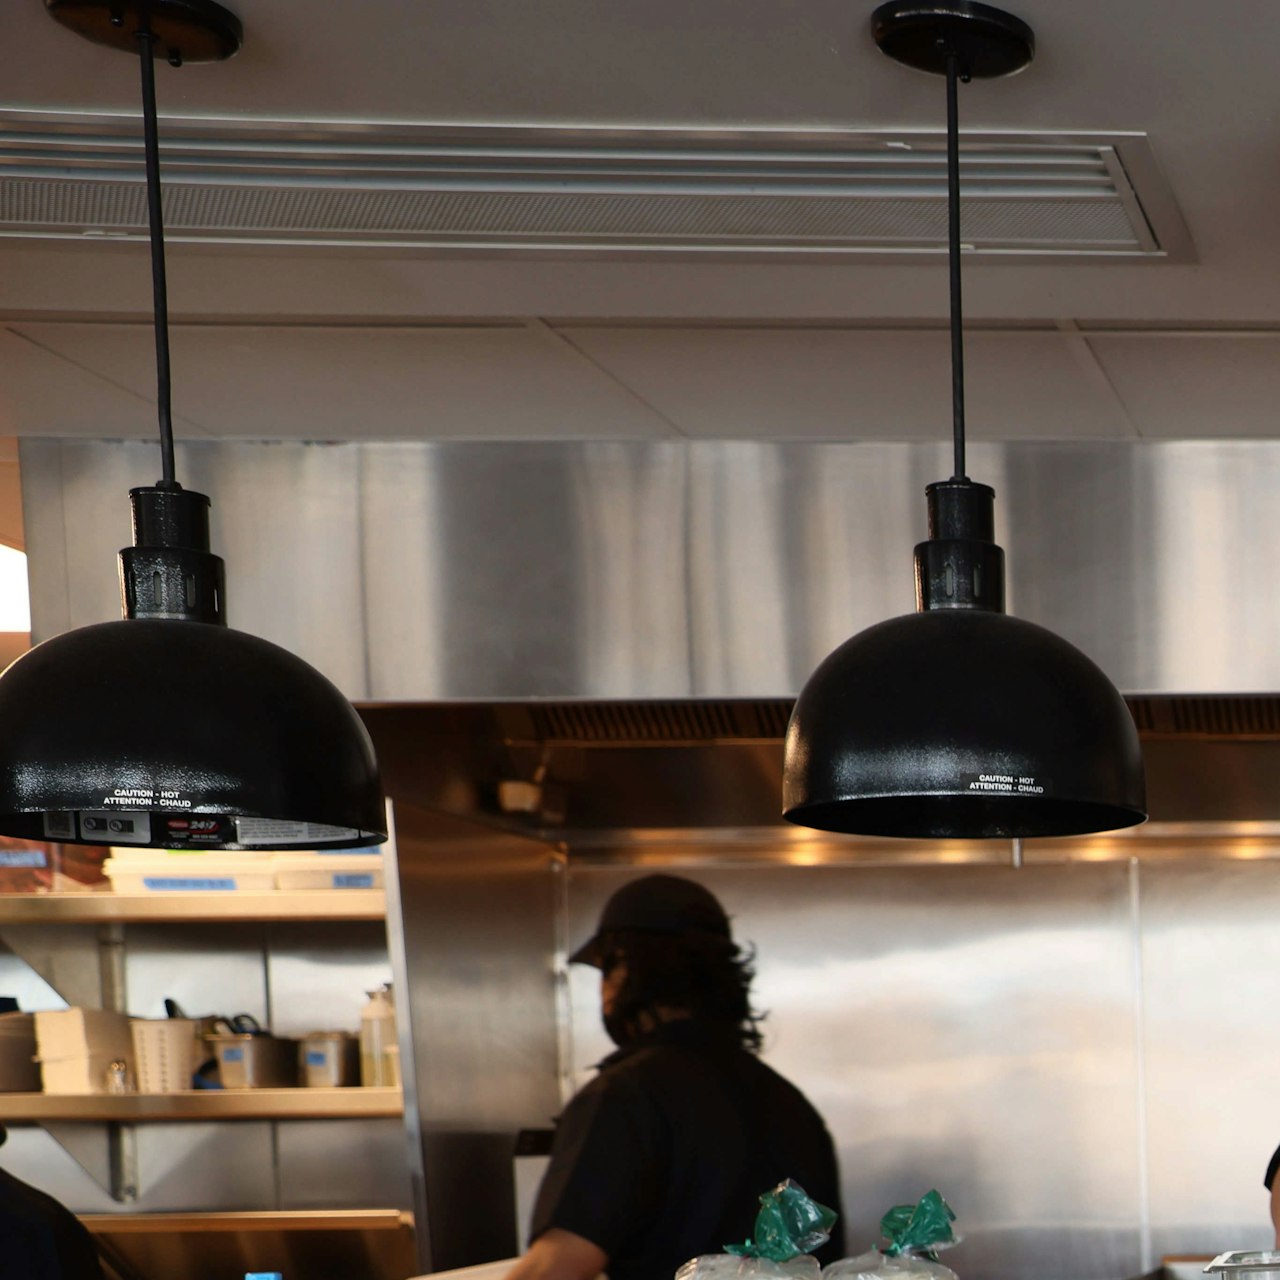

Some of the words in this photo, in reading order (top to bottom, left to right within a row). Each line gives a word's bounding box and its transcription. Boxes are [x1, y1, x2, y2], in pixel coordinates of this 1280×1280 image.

[979, 774, 1013, 782] CAUTION
[114, 789, 154, 797] CAUTION
[1018, 785, 1044, 793] CHAUD
[103, 797, 152, 805] ATTENTION
[159, 799, 191, 807] CHAUD
